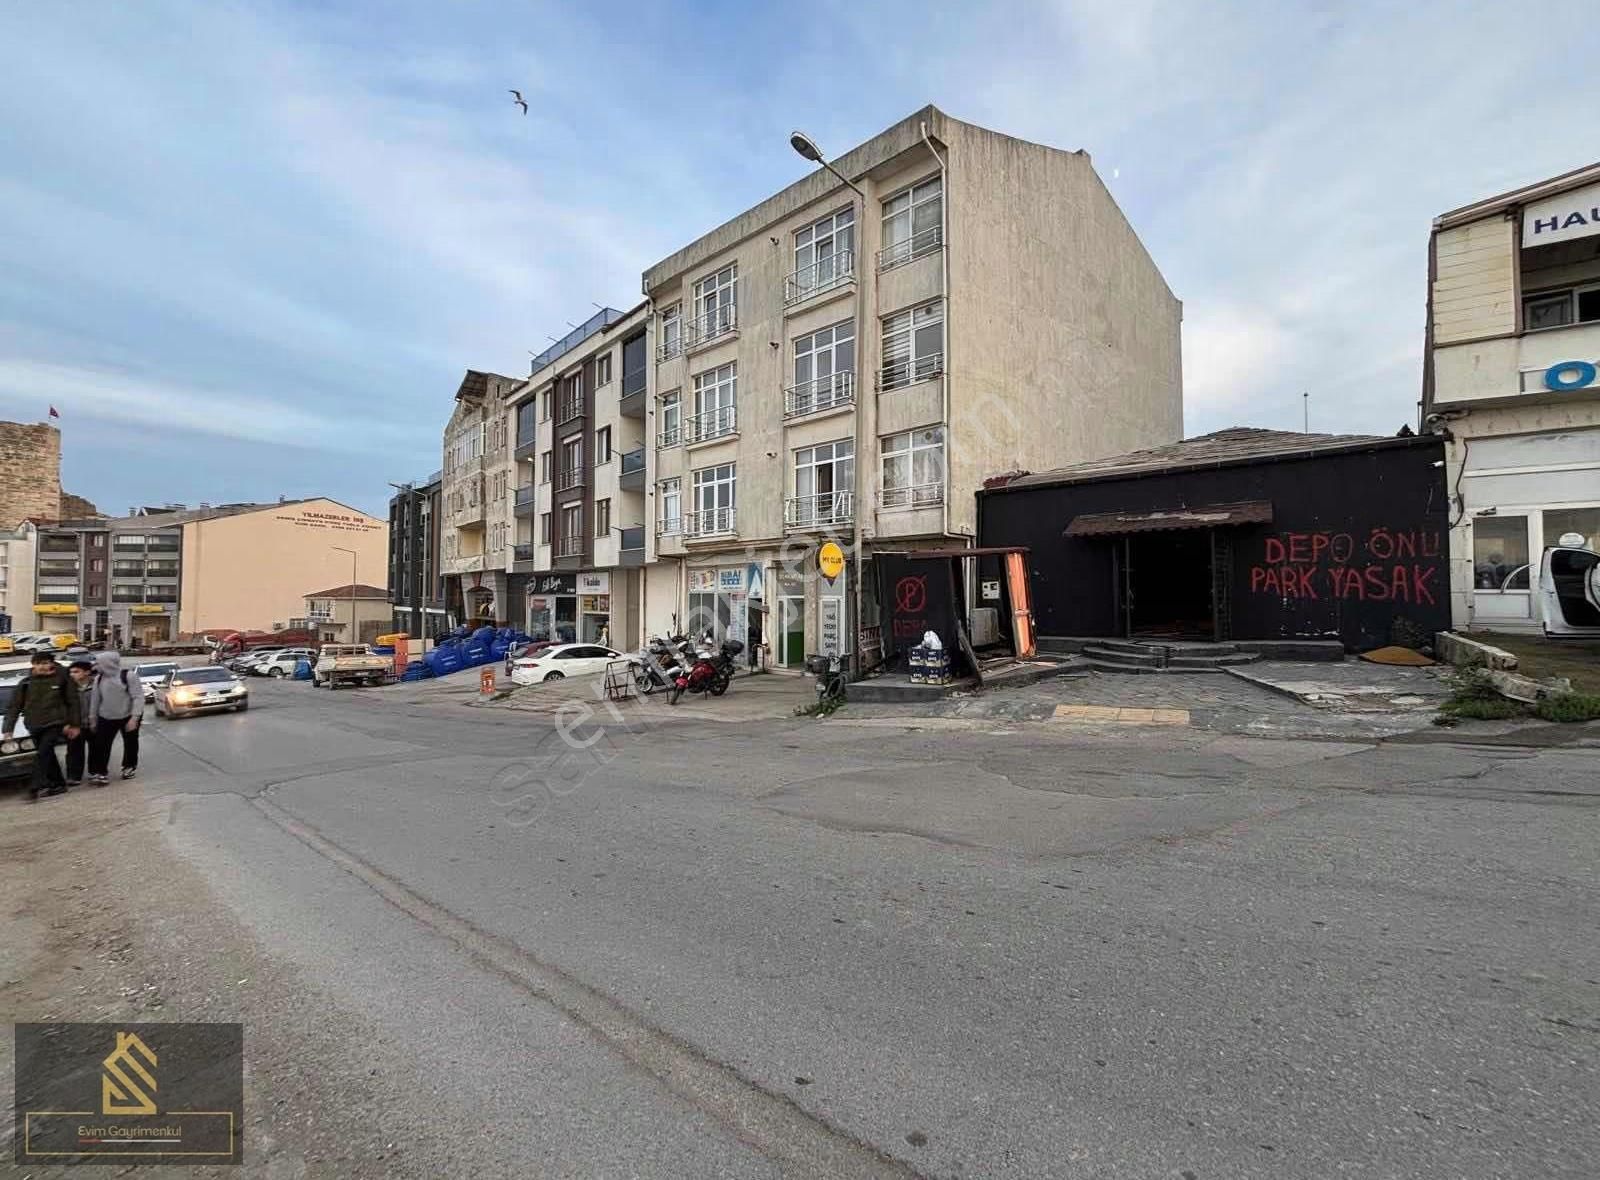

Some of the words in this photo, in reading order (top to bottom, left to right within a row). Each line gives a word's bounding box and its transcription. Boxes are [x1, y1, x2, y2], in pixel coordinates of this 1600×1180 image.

[1544, 361, 1600, 391] O
[830, 556, 842, 564] CLUB
[1264, 531, 1354, 563] DEPO
[1251, 566, 1319, 599] PARK
[1328, 564, 1437, 605] YASAK
